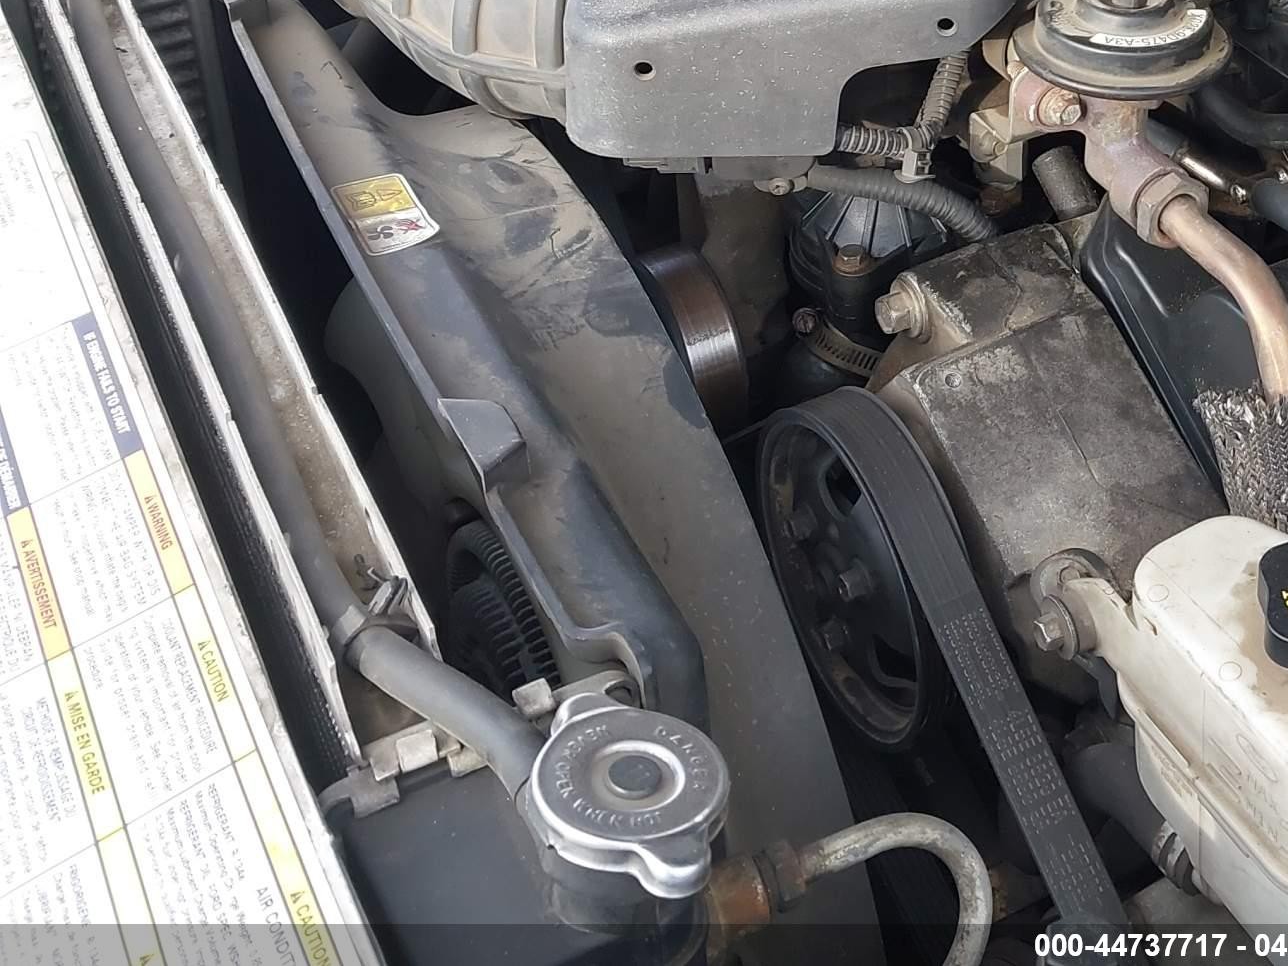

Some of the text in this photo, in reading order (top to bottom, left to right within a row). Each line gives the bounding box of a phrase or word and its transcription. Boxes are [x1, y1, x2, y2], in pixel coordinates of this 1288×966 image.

[104, 391, 120, 407] TO
[108, 405, 131, 435] START
[148, 504, 175, 551] WARNING
[22, 552, 58, 630] AVERTISSEMENT
[200, 649, 230, 702] CAUTION
[65, 701, 106, 795] MISE EN GARDE
[256, 886, 274, 911] AIR
